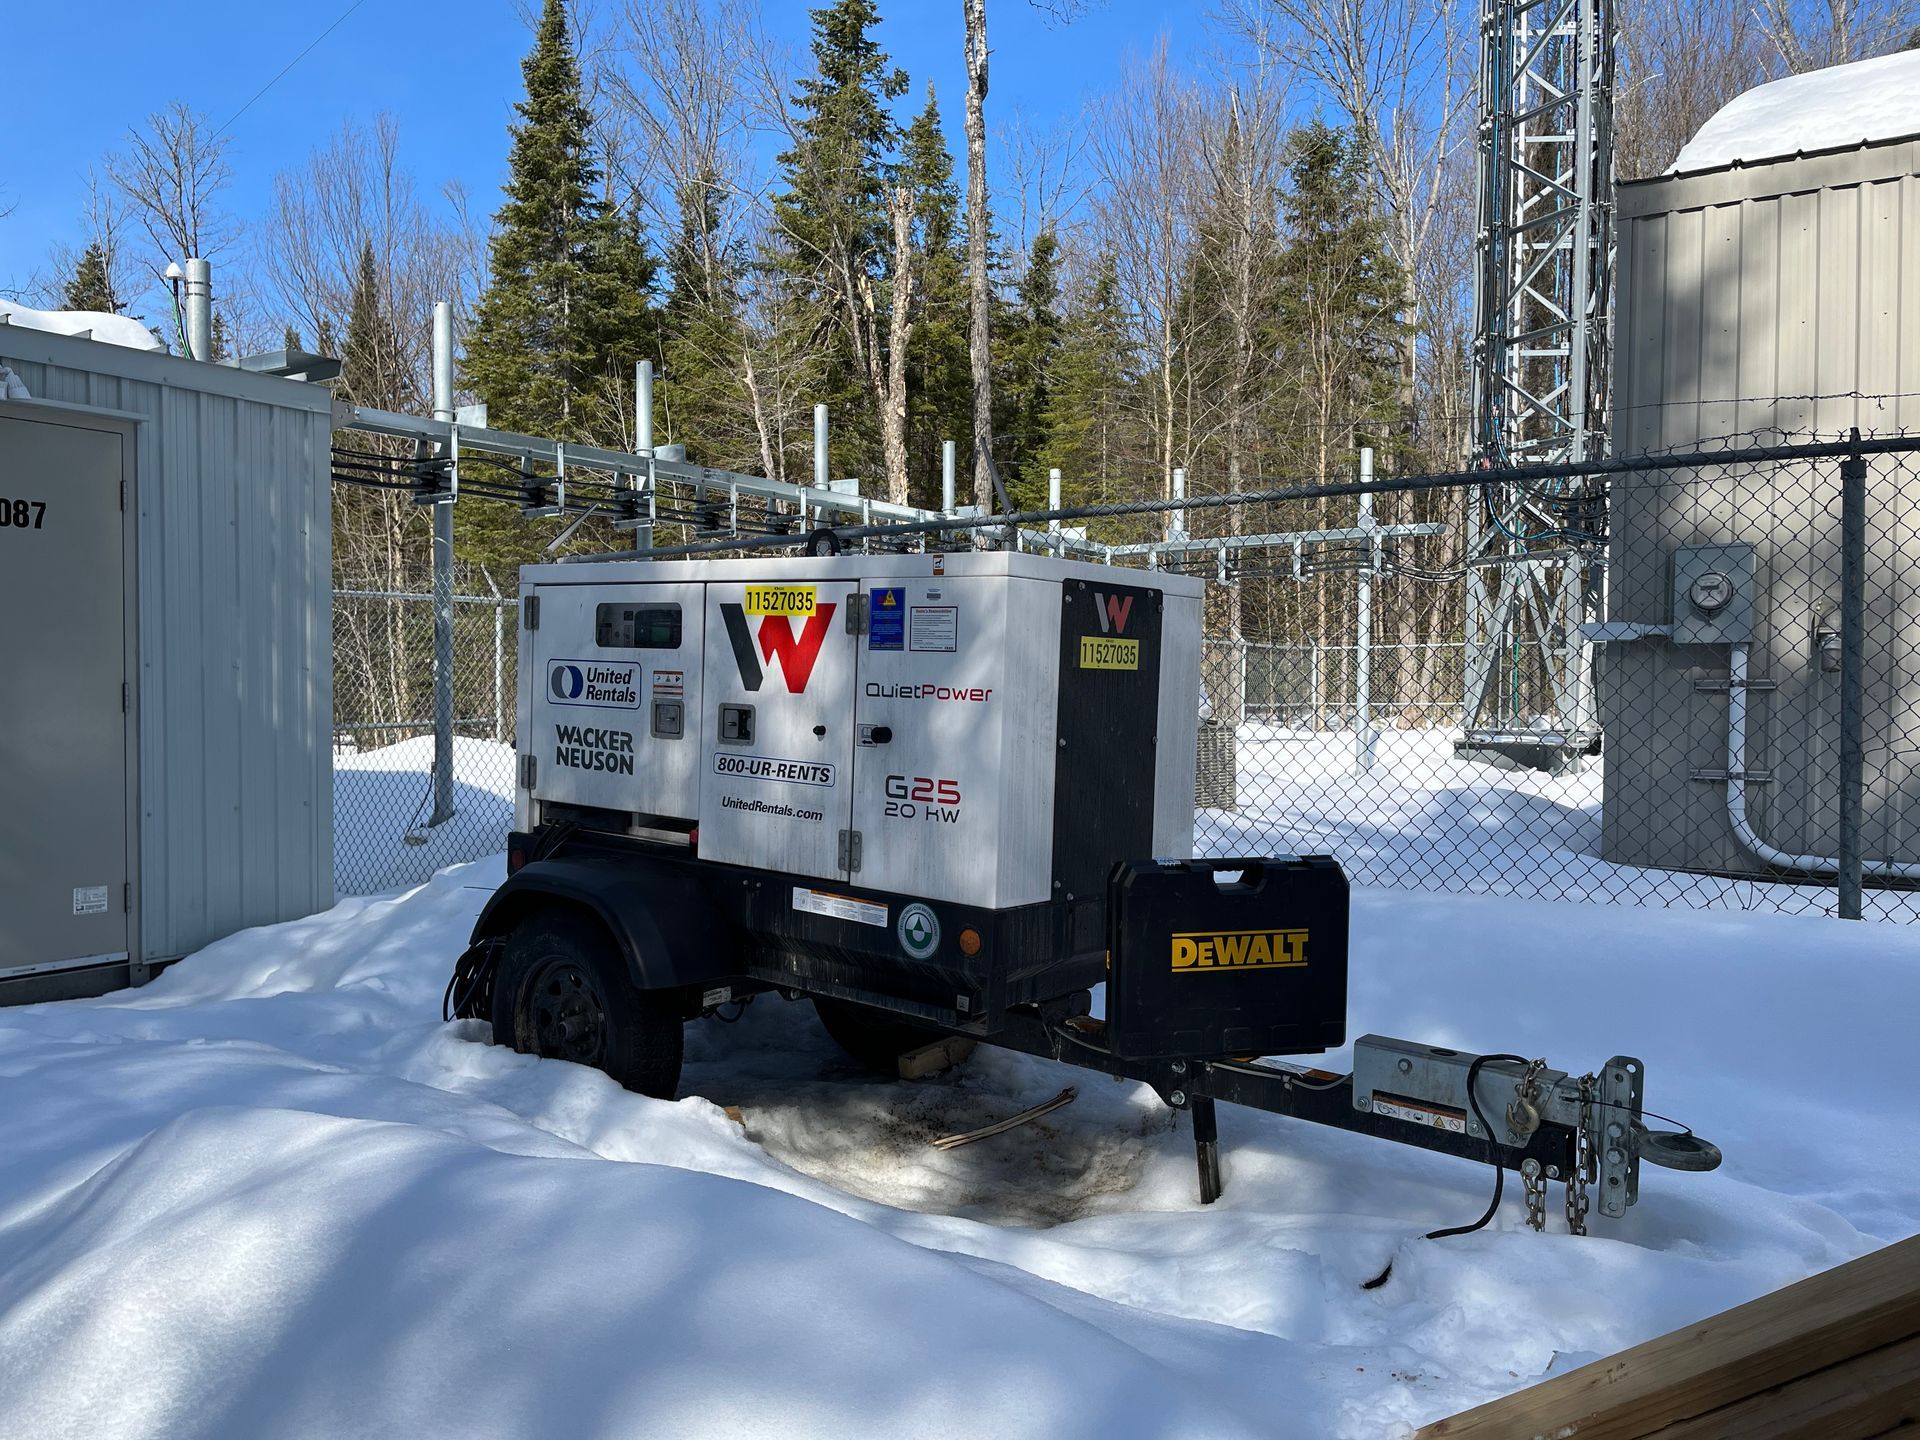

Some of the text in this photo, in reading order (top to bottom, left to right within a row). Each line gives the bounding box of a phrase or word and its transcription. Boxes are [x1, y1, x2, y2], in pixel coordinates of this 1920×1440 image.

[0, 498, 46, 529] 087
[747, 591, 813, 611] 11527035
[1083, 643, 1137, 665] 11527035
[586, 667, 633, 685] United
[585, 685, 637, 703] Rentals
[865, 682, 993, 702] QuietPower
[555, 724, 634, 753] WACKER
[556, 746, 634, 776] NEUSON
[717, 757, 831, 783] 800-UR-RENTS
[885, 775, 961, 805] G25
[721, 796, 823, 821] UnitedRentals.com
[884, 801, 916, 819] 20
